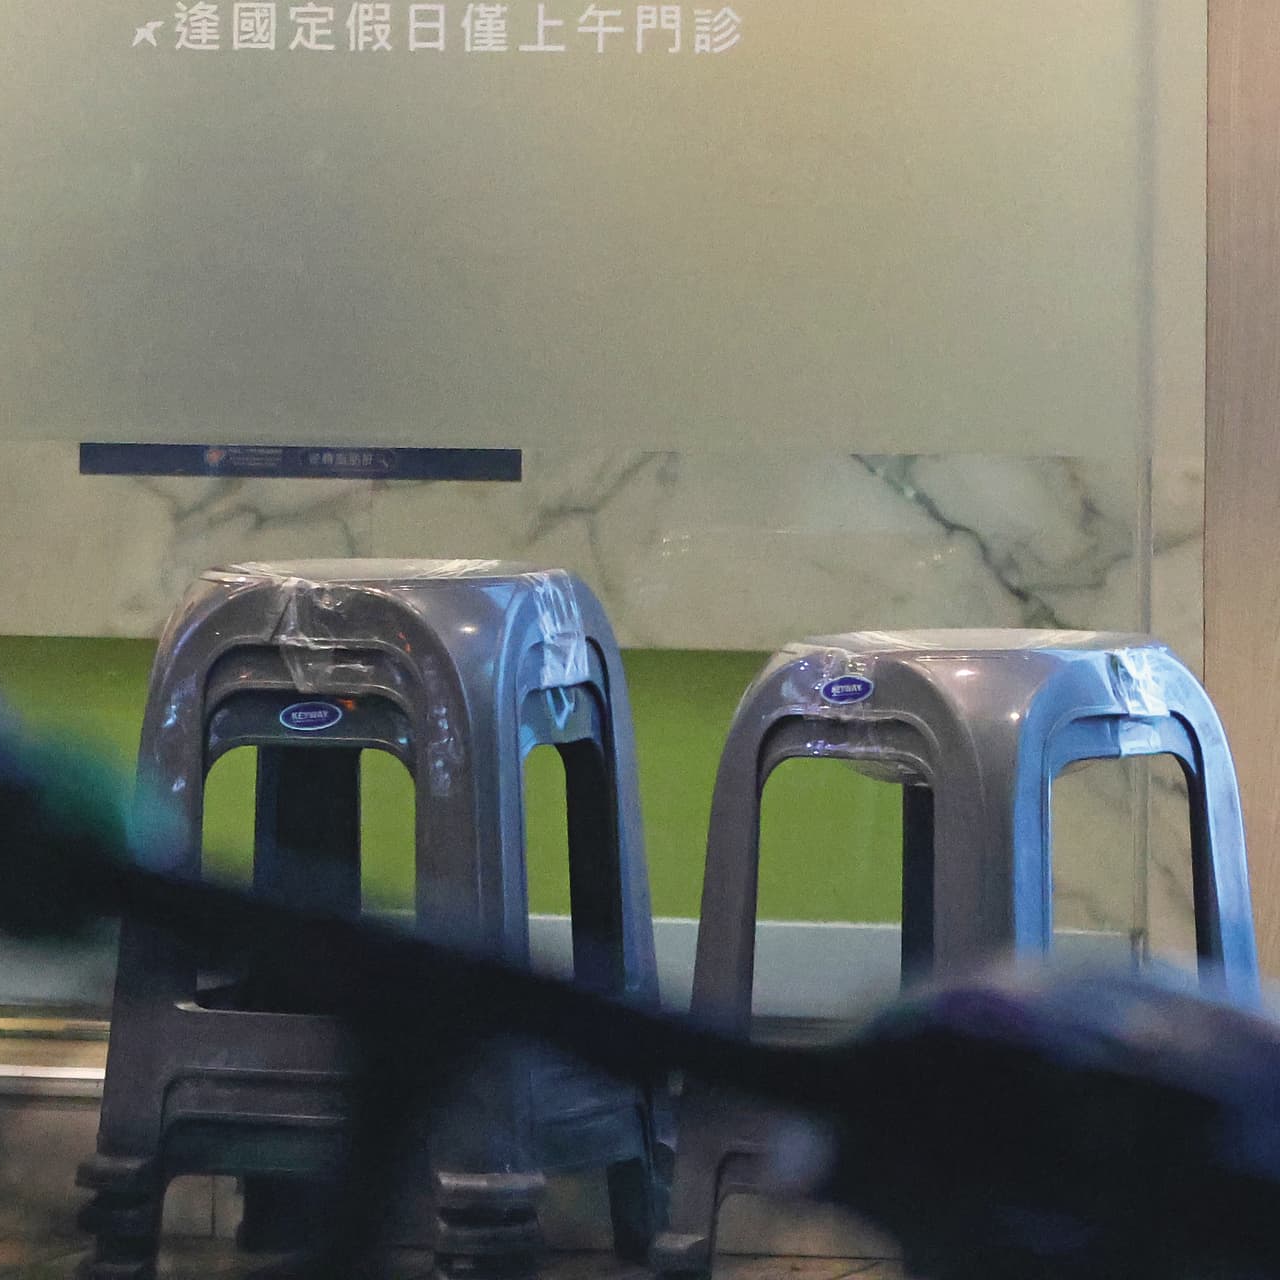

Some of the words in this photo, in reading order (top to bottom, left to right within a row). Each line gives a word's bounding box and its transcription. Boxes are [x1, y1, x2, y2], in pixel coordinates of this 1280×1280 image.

[173, 0, 745, 56] 逢國定假日僅上午門診
